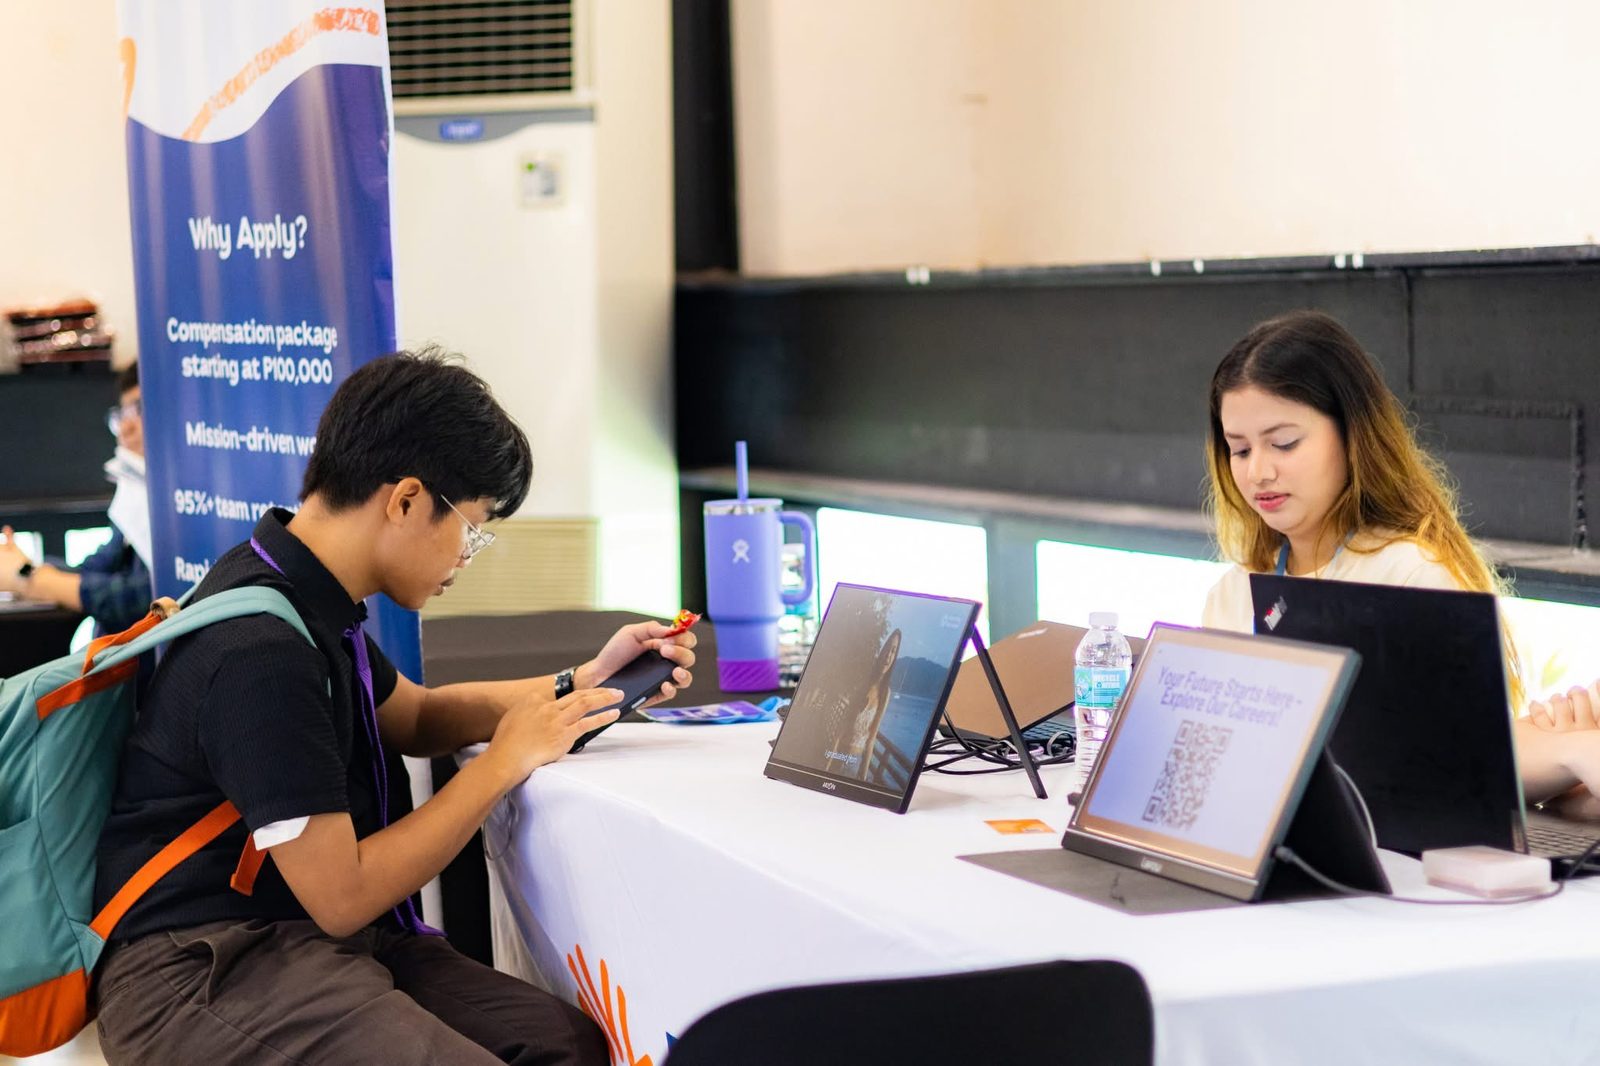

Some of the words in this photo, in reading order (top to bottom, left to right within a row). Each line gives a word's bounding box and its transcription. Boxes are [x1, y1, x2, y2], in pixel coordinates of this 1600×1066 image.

[188, 216, 232, 260] Why
[236, 214, 308, 260] Apply?
[167, 317, 275, 349] Compensation
[275, 321, 338, 354] package
[181, 354, 240, 387] starting
[241, 358, 261, 381] at
[262, 355, 333, 386] P100,000
[185, 421, 296, 455] Mission-driven
[296, 437, 317, 457] wo
[174, 489, 214, 515] 95%+
[215, 495, 250, 521] team
[1159, 666, 1185, 688] Your
[1184, 670, 1224, 695] Future
[1223, 678, 1264, 703] Starts
[1264, 686, 1295, 710] Here
[1160, 686, 1206, 711] Explore
[1206, 696, 1229, 716] Our
